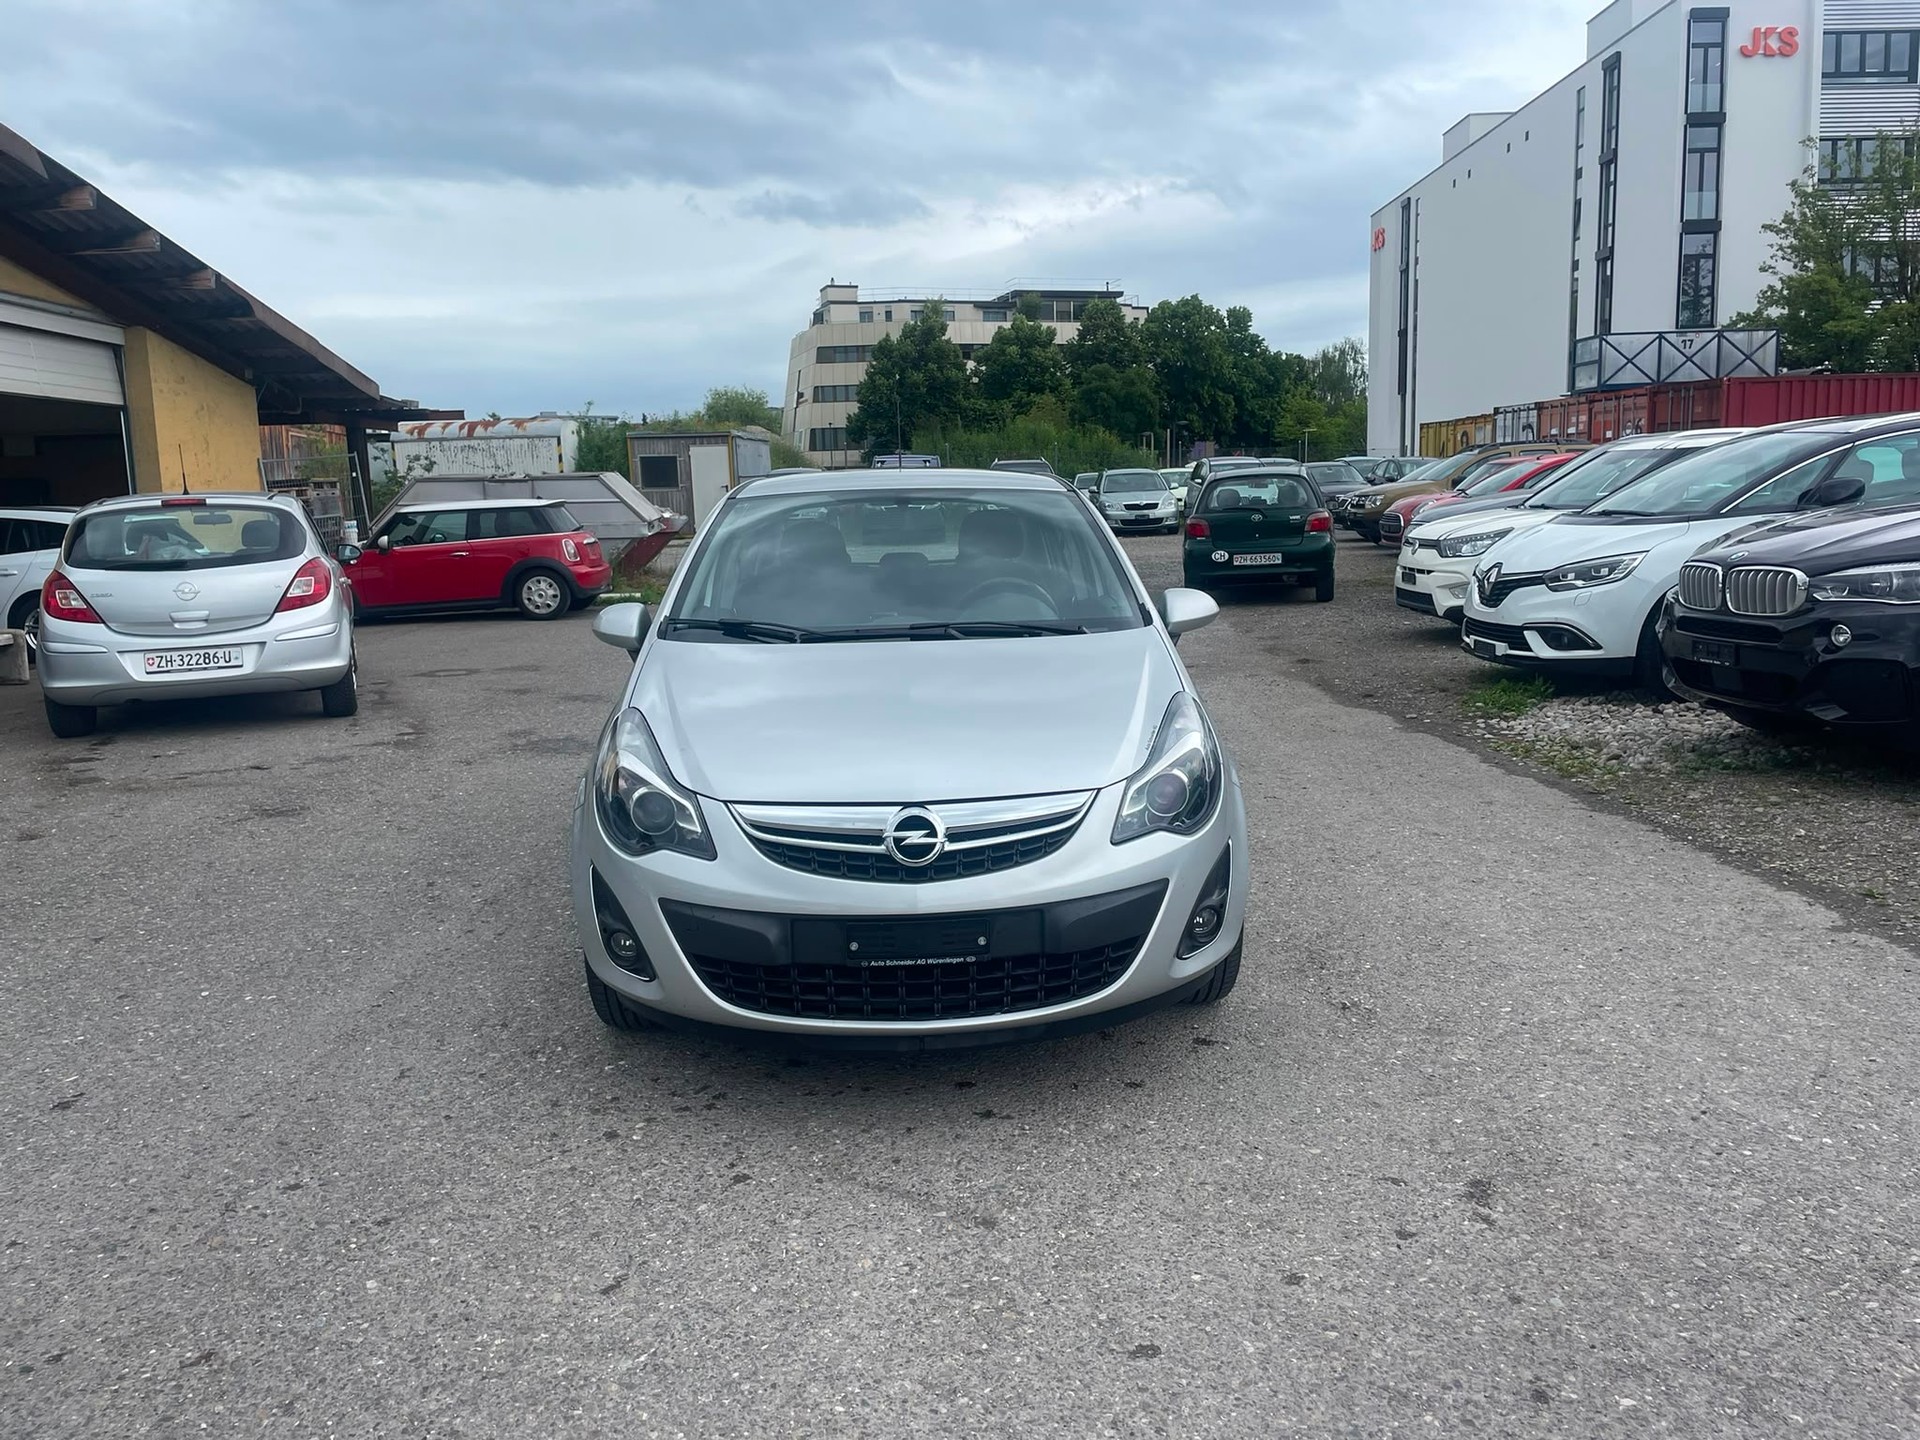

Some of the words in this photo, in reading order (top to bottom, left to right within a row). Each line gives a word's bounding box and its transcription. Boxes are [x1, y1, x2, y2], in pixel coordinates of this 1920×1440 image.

[1740, 26, 1799, 57] JKS
[1681, 339, 1694, 350] 17
[1213, 551, 1226, 561] CH
[1239, 555, 1248, 563] ZH
